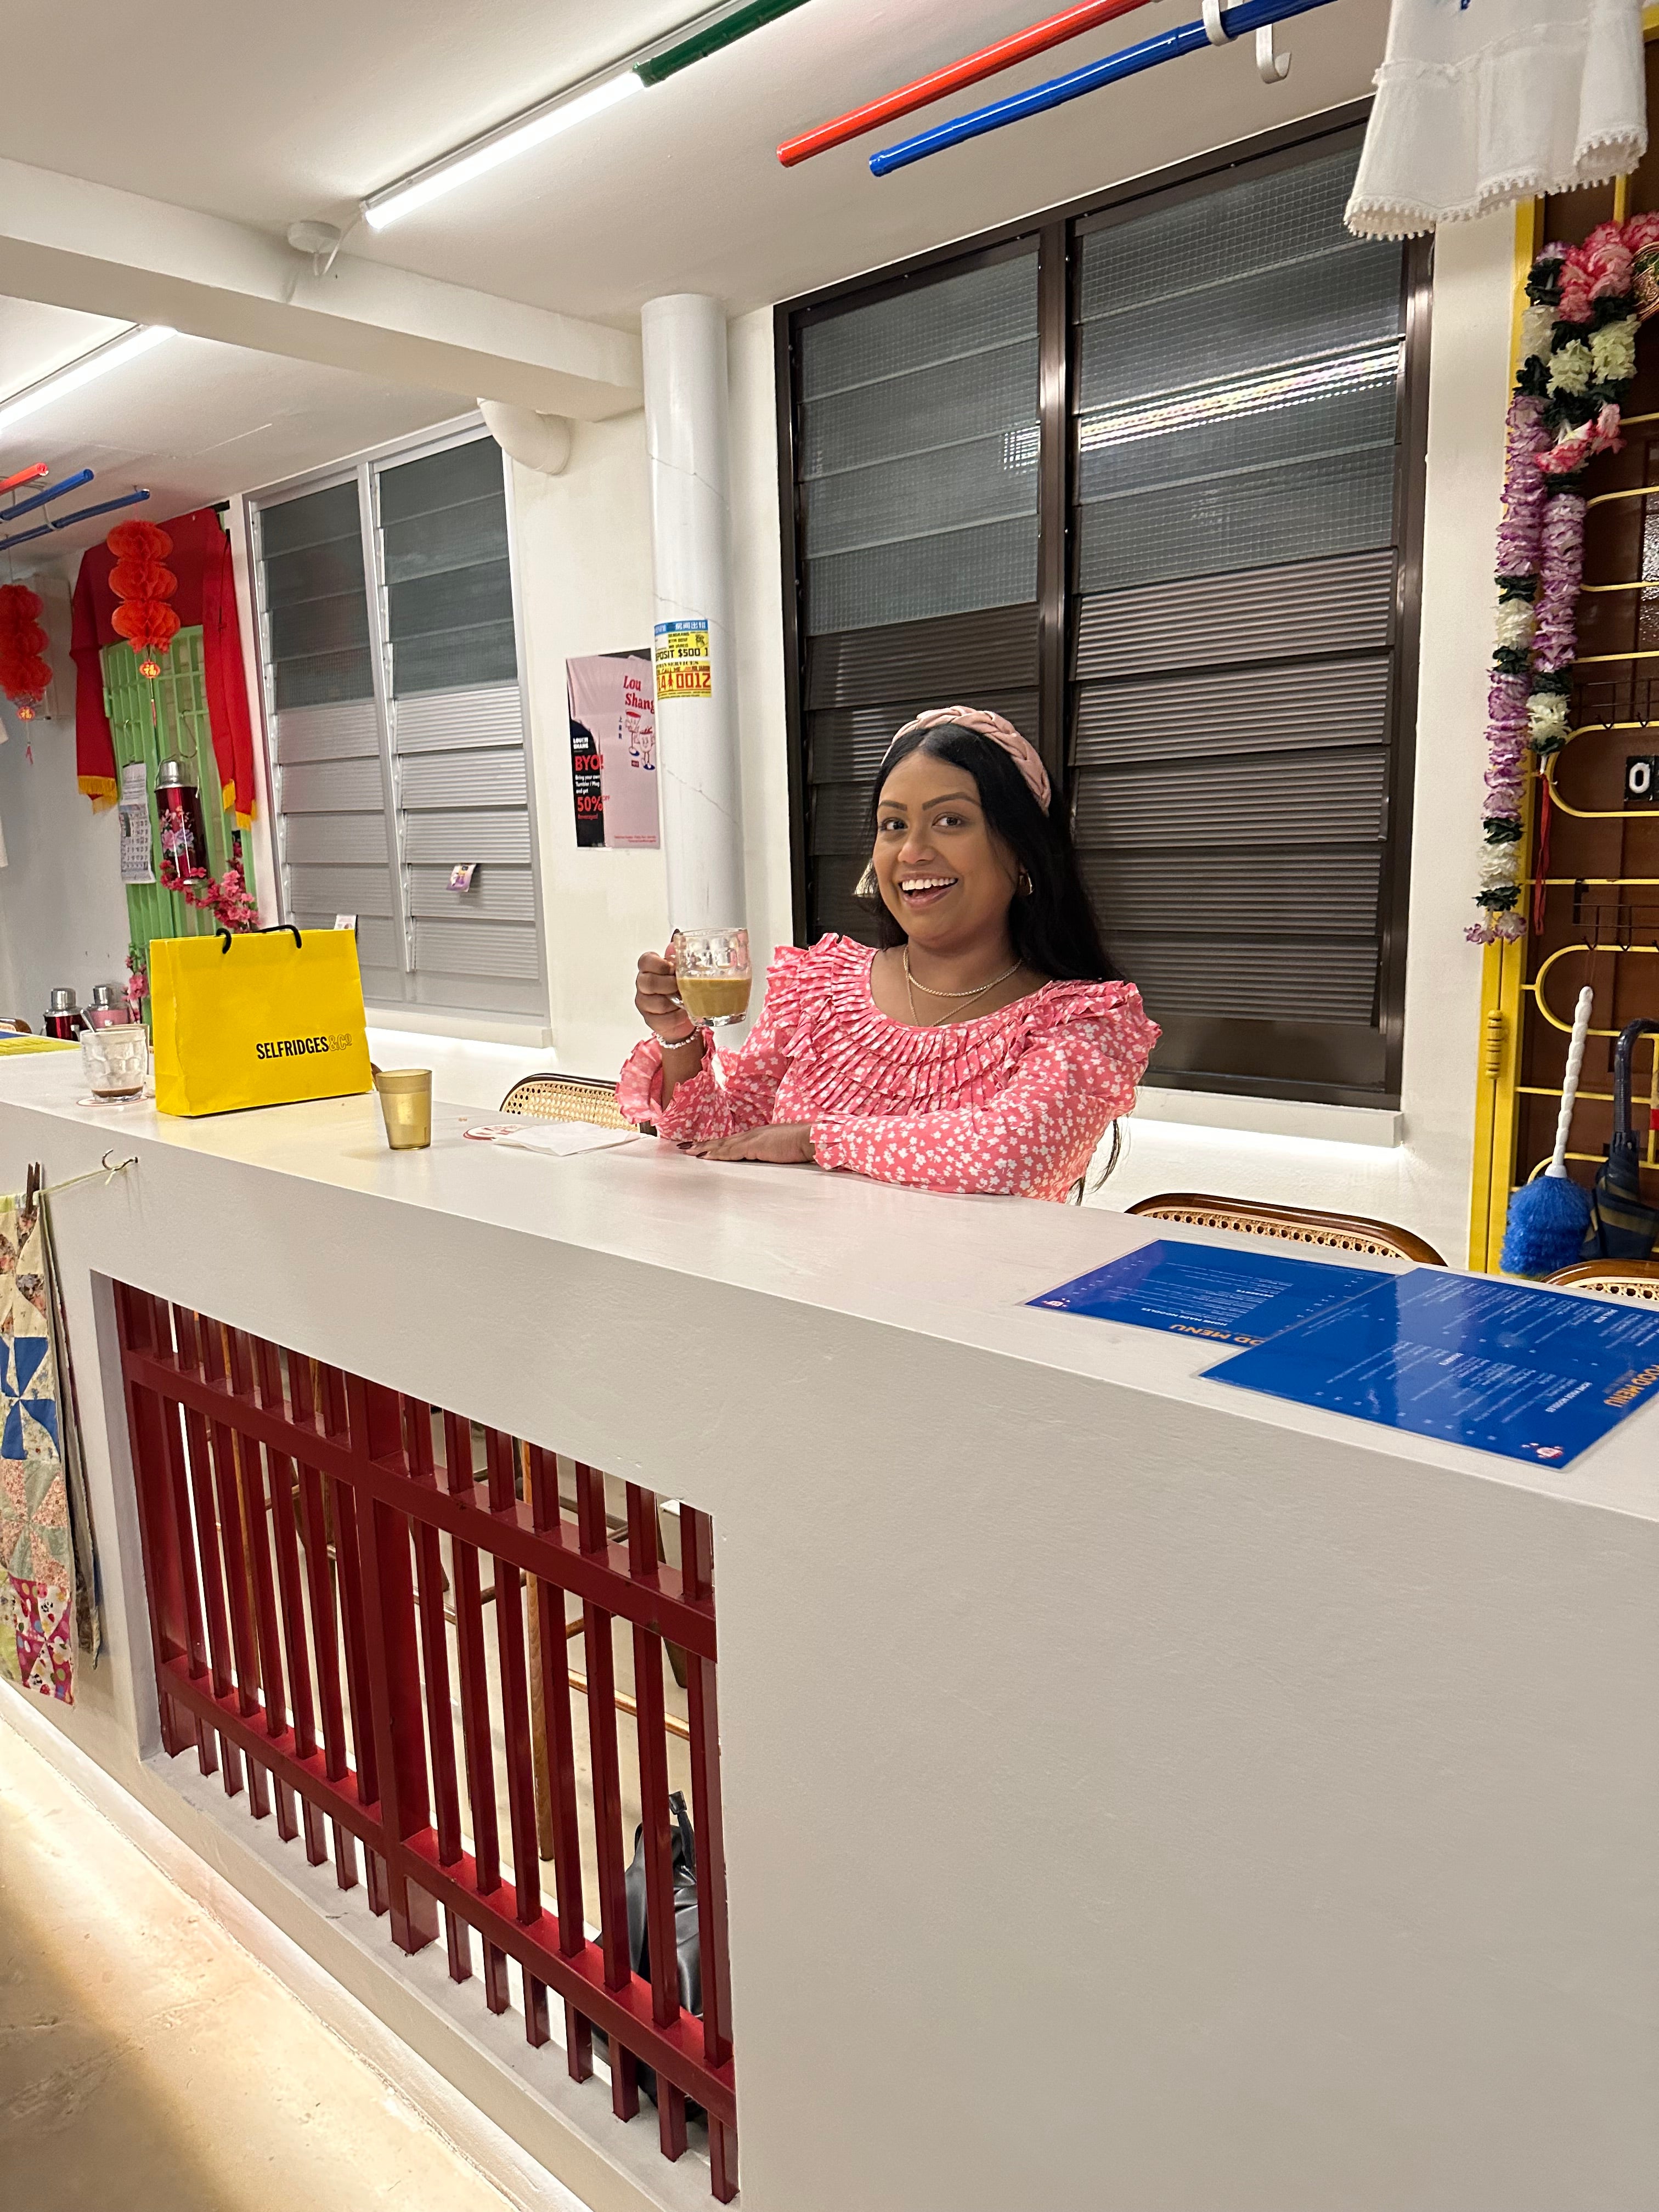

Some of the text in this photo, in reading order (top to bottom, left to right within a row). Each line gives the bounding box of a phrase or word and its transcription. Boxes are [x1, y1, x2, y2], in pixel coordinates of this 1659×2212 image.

[678, 648, 701, 658] $500
[623, 675, 641, 691] Lou
[676, 672, 711, 689] 0012
[625, 692, 655, 714] Shang
[574, 754, 603, 771] BYO!
[1629, 762, 1651, 794] 0
[577, 795, 603, 812] 50%
[1141, 1307, 1179, 1318] NOODLES
[1169, 1324, 1232, 1340] MENU
[1603, 1383, 1645, 1408] MENU
